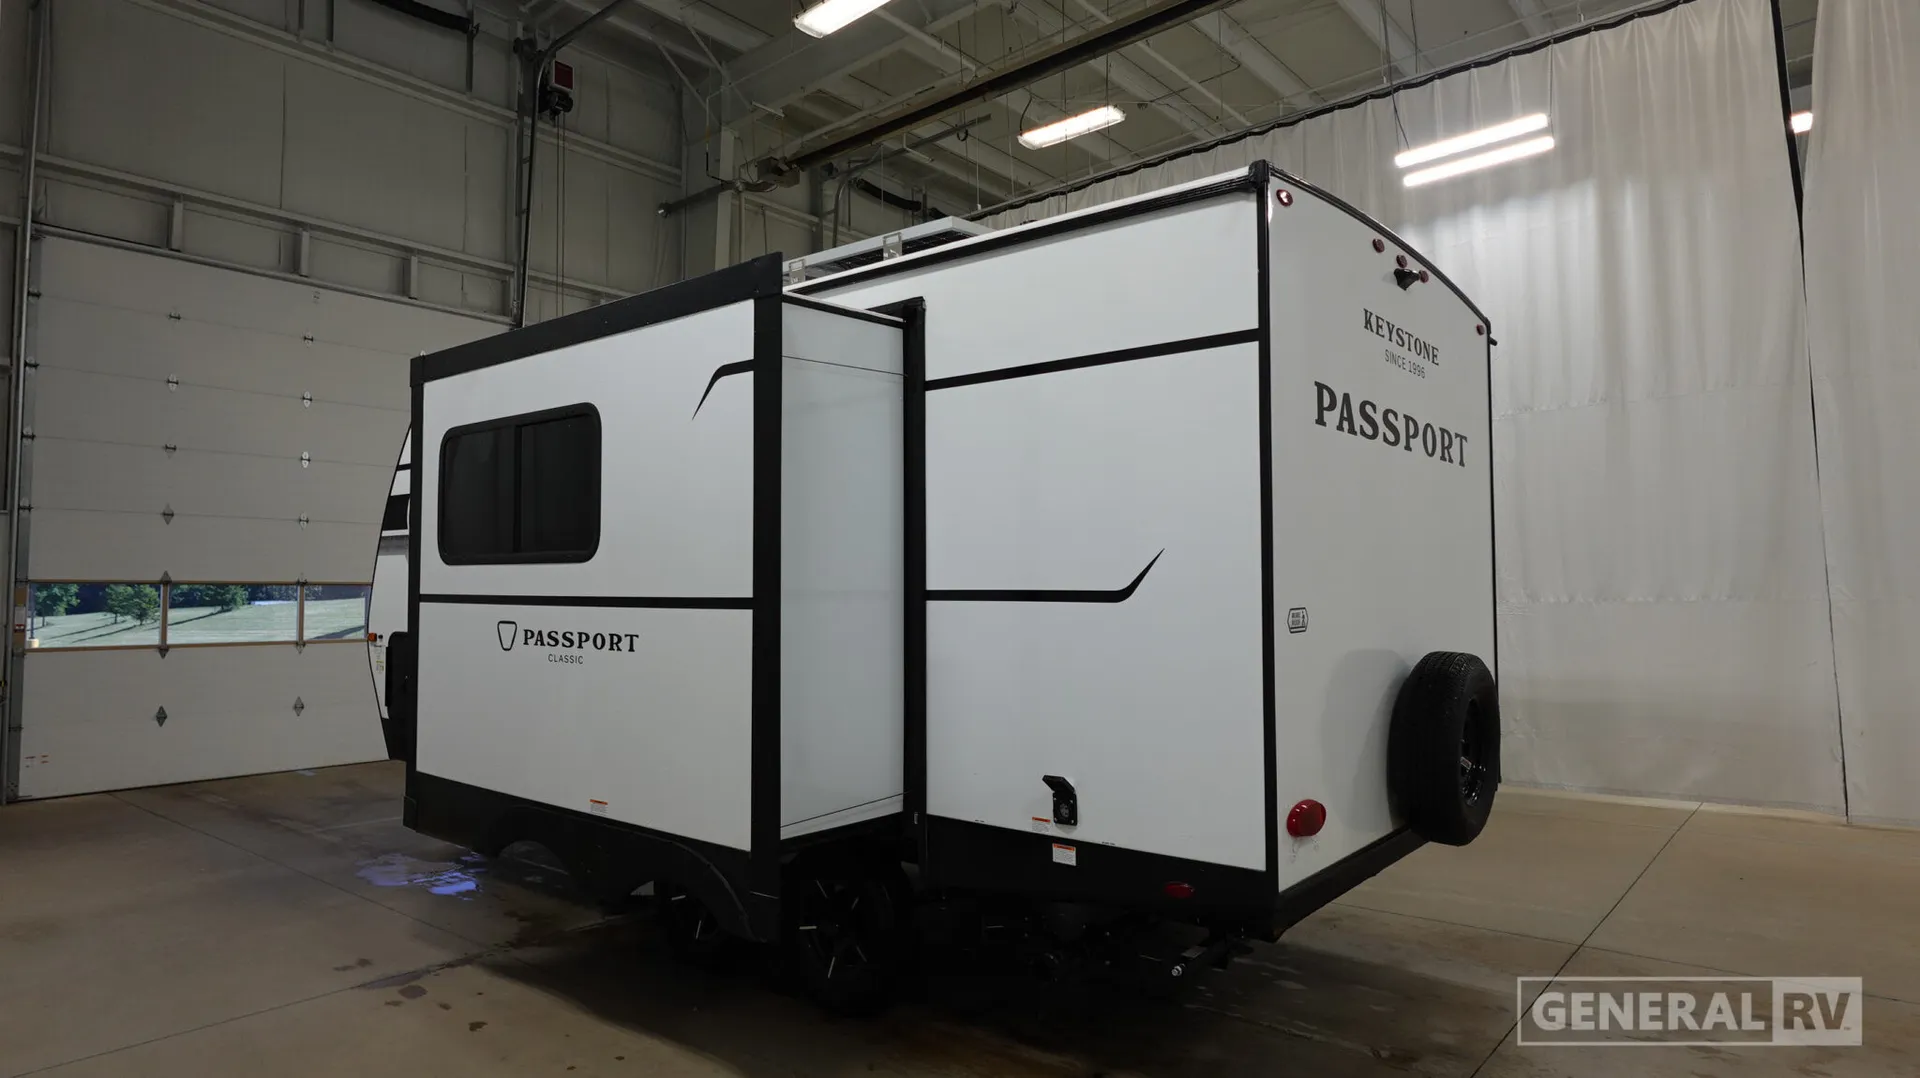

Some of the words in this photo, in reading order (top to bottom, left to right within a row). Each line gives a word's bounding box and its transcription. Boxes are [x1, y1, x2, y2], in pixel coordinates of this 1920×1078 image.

[1363, 308, 1439, 366] KEYSTONE
[1384, 349, 1407, 371] SINCE
[1408, 360, 1426, 379] 1996
[1314, 380, 1468, 468] PASSPORT
[523, 629, 639, 652] PASSPORT
[547, 653, 584, 665] CLASSIC
